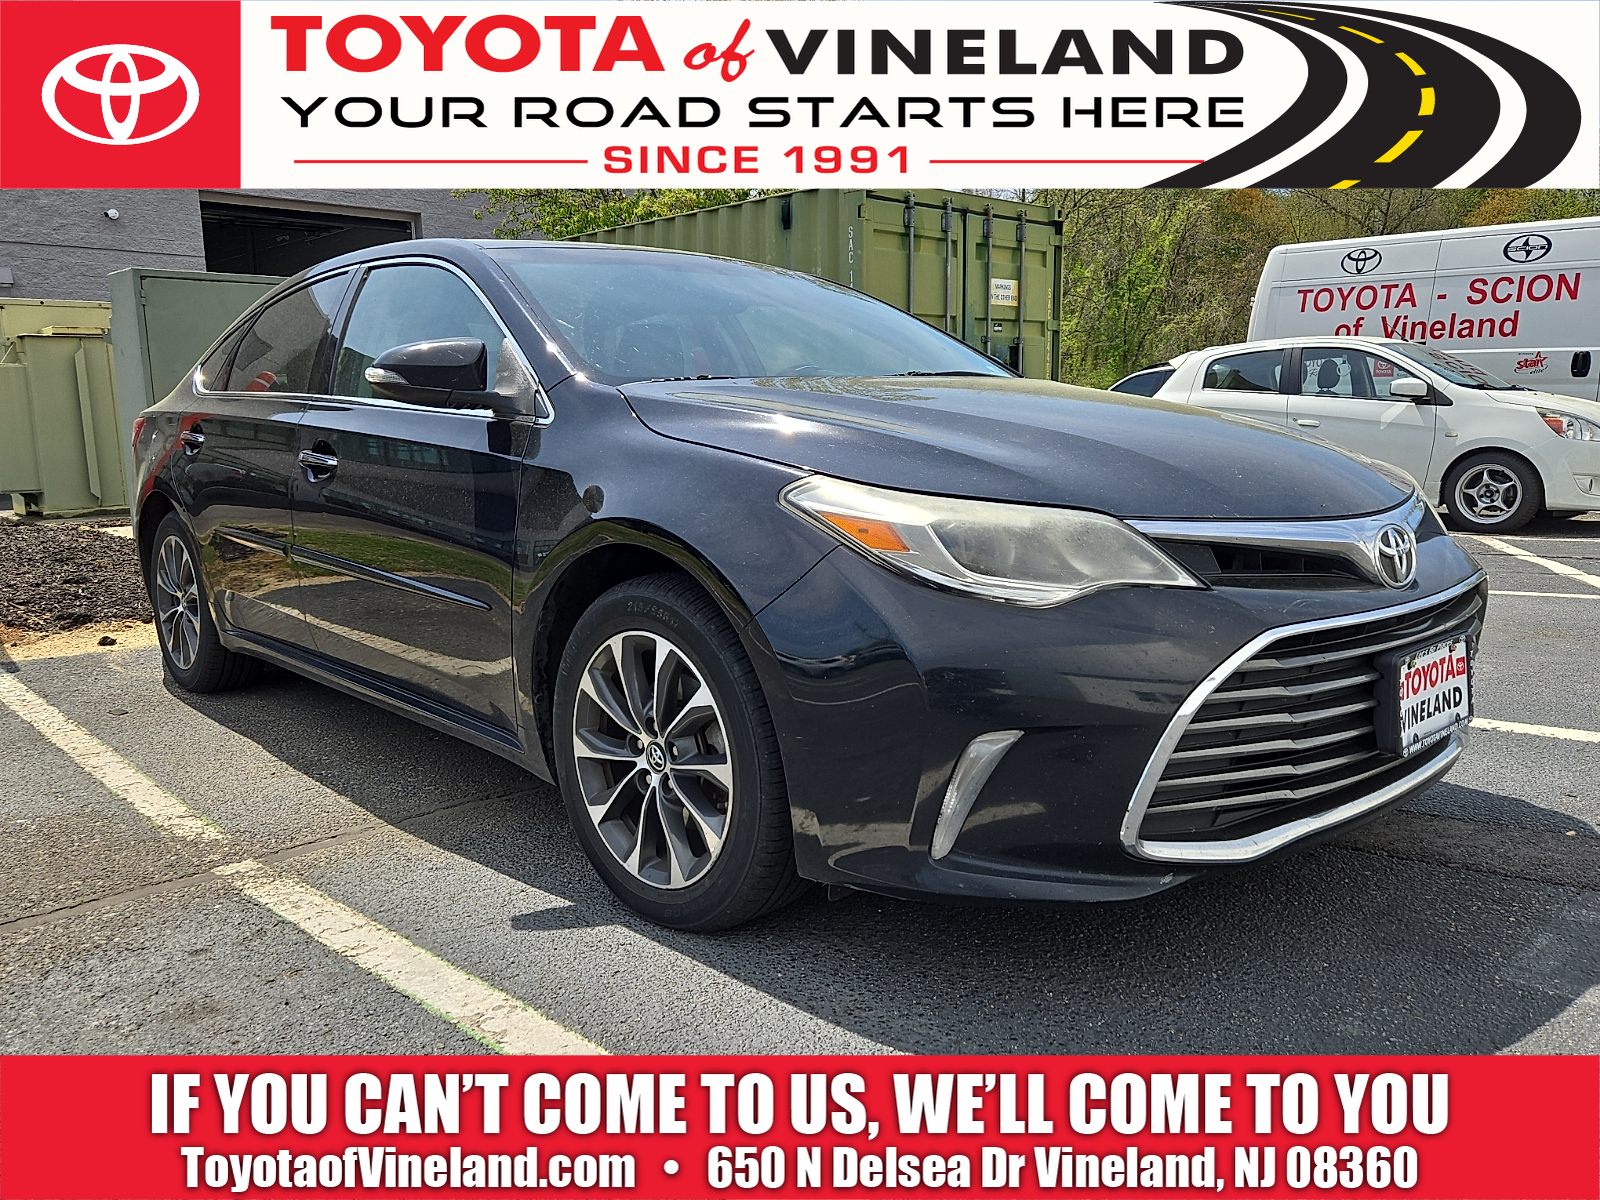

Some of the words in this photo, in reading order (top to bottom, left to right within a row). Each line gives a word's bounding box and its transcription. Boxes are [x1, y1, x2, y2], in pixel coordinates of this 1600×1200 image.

[1297, 283, 1417, 312] TOYOTA
[1467, 272, 1581, 305] SCION
[1334, 316, 1365, 337] of
[1381, 310, 1520, 340] Vineland
[1404, 653, 1456, 700] TOYOTA
[1401, 686, 1463, 734] VINELAND
